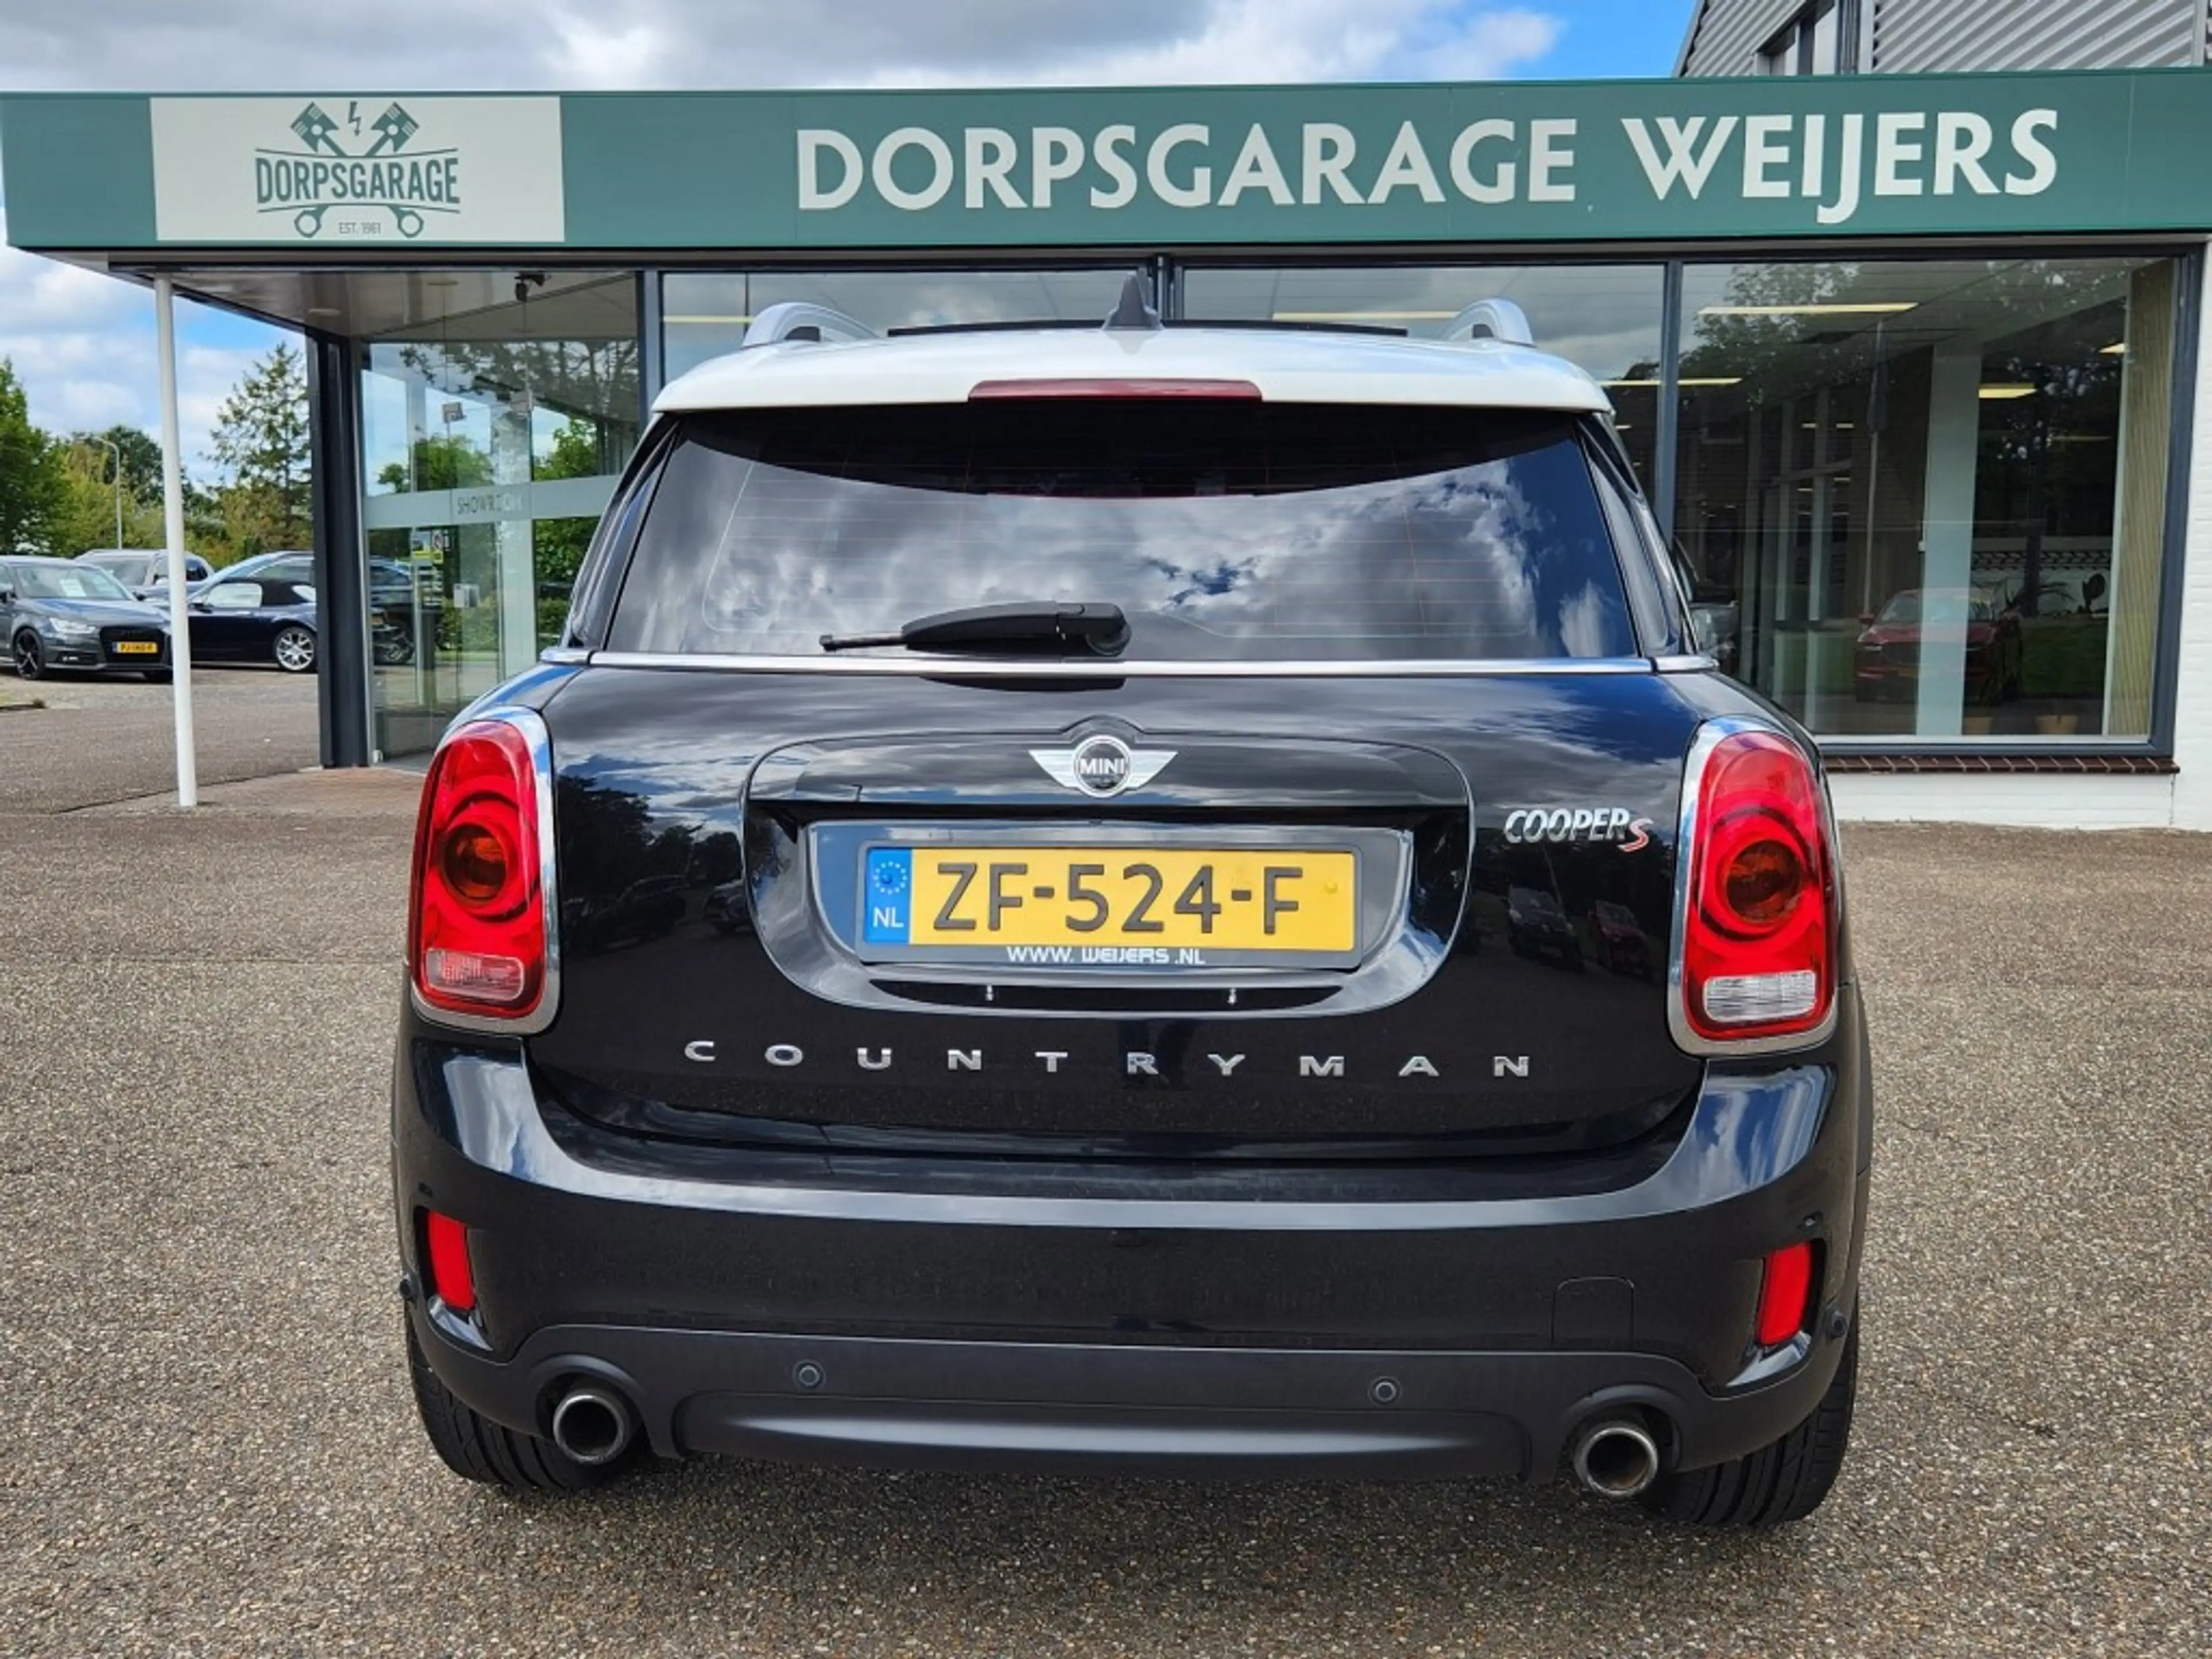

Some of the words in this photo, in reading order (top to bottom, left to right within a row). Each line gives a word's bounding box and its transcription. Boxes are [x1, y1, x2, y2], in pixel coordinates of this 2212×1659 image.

[255, 157, 461, 204] DORPSGARAGE
[797, 118, 1578, 210] DORPSGARAGE
[1620, 108, 2058, 224] WEIJERS
[338, 222, 359, 234] EST.
[1080, 757, 1125, 775] MINI
[1503, 806, 1630, 843] COOPER
[1616, 817, 1654, 853] S
[873, 907, 904, 928] NL
[933, 862, 1304, 935] ZF-524-F
[684, 1040, 1530, 1077] COUNTRYMAN
